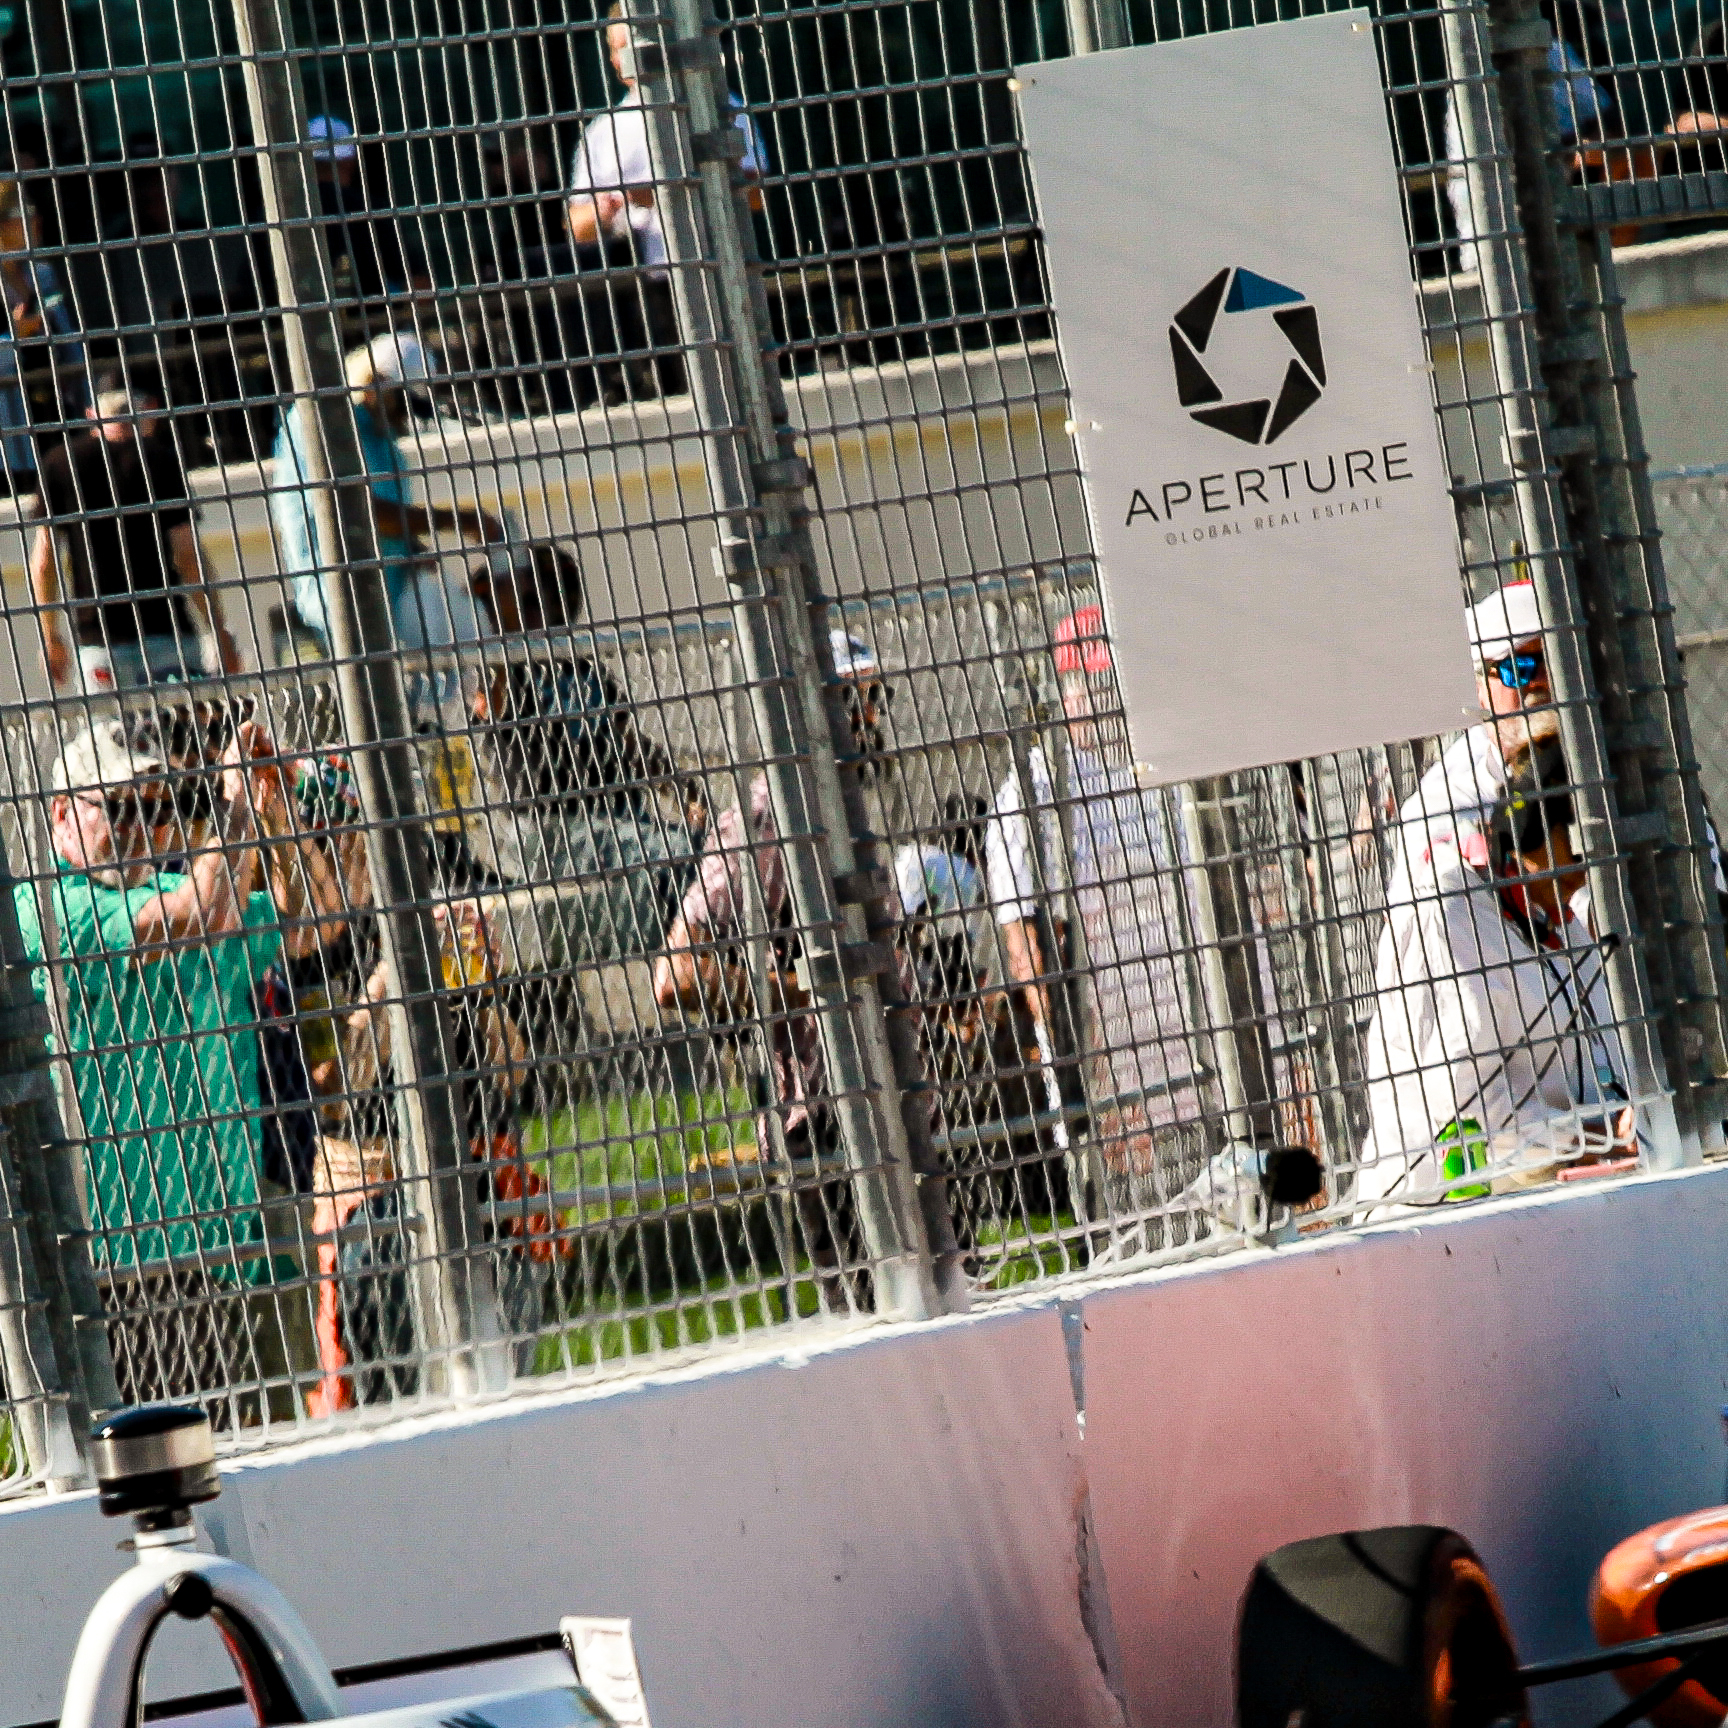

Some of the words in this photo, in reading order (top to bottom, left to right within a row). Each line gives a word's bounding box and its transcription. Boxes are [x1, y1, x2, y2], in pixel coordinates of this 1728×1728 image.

[1125, 442, 1414, 527] APERTURE
[1165, 519, 1242, 546] GLOBAL
[1253, 510, 1301, 530] REAL
[1312, 495, 1384, 521] ESTATE
